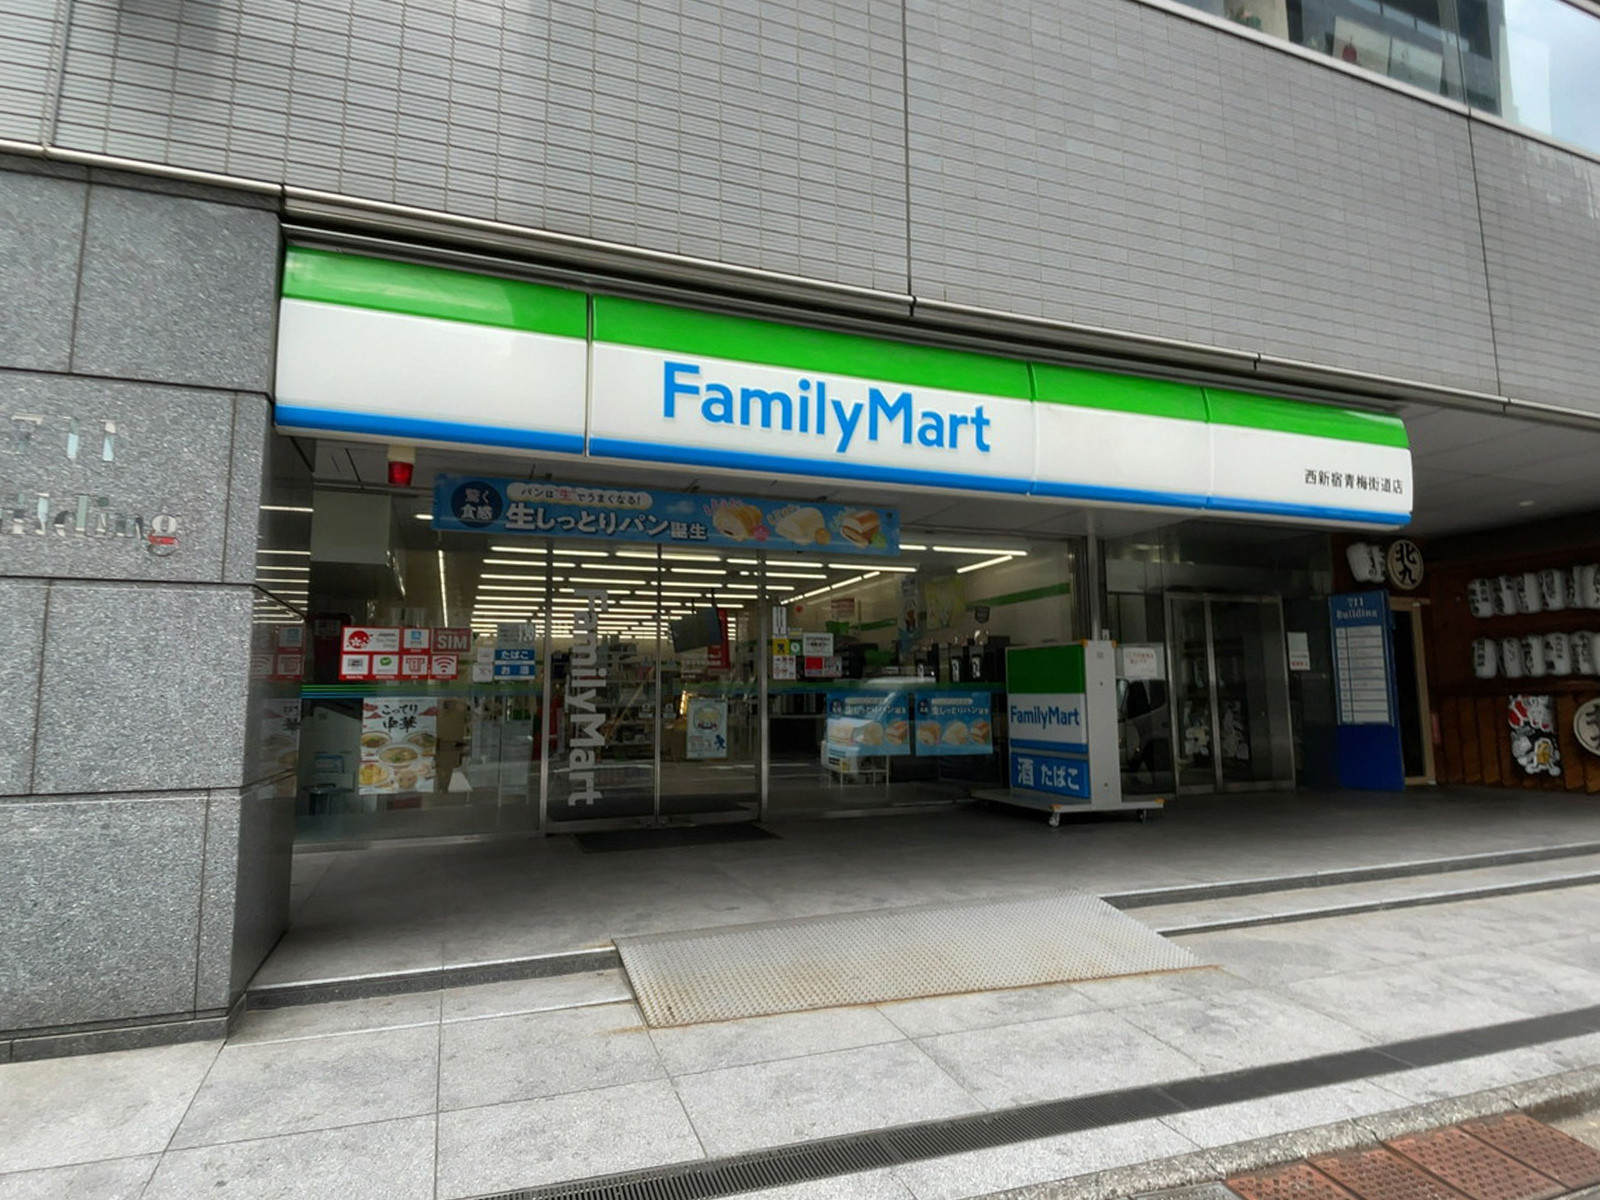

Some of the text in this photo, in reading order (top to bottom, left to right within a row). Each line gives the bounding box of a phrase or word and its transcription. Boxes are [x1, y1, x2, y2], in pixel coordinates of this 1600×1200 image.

[663, 361, 991, 453] FamilyMart
[1304, 468, 1404, 495] 西新宿青梅街道店
[0, 492, 179, 558] ilding
[437, 635, 468, 650] SIM
[501, 650, 529, 660] たばこ
[381, 704, 419, 715] こってり
[564, 588, 609, 807] FamilyMart
[382, 715, 418, 733] 中華
[1010, 704, 1081, 730] FamilyMart
[1017, 757, 1080, 791] 酒 たばこ
